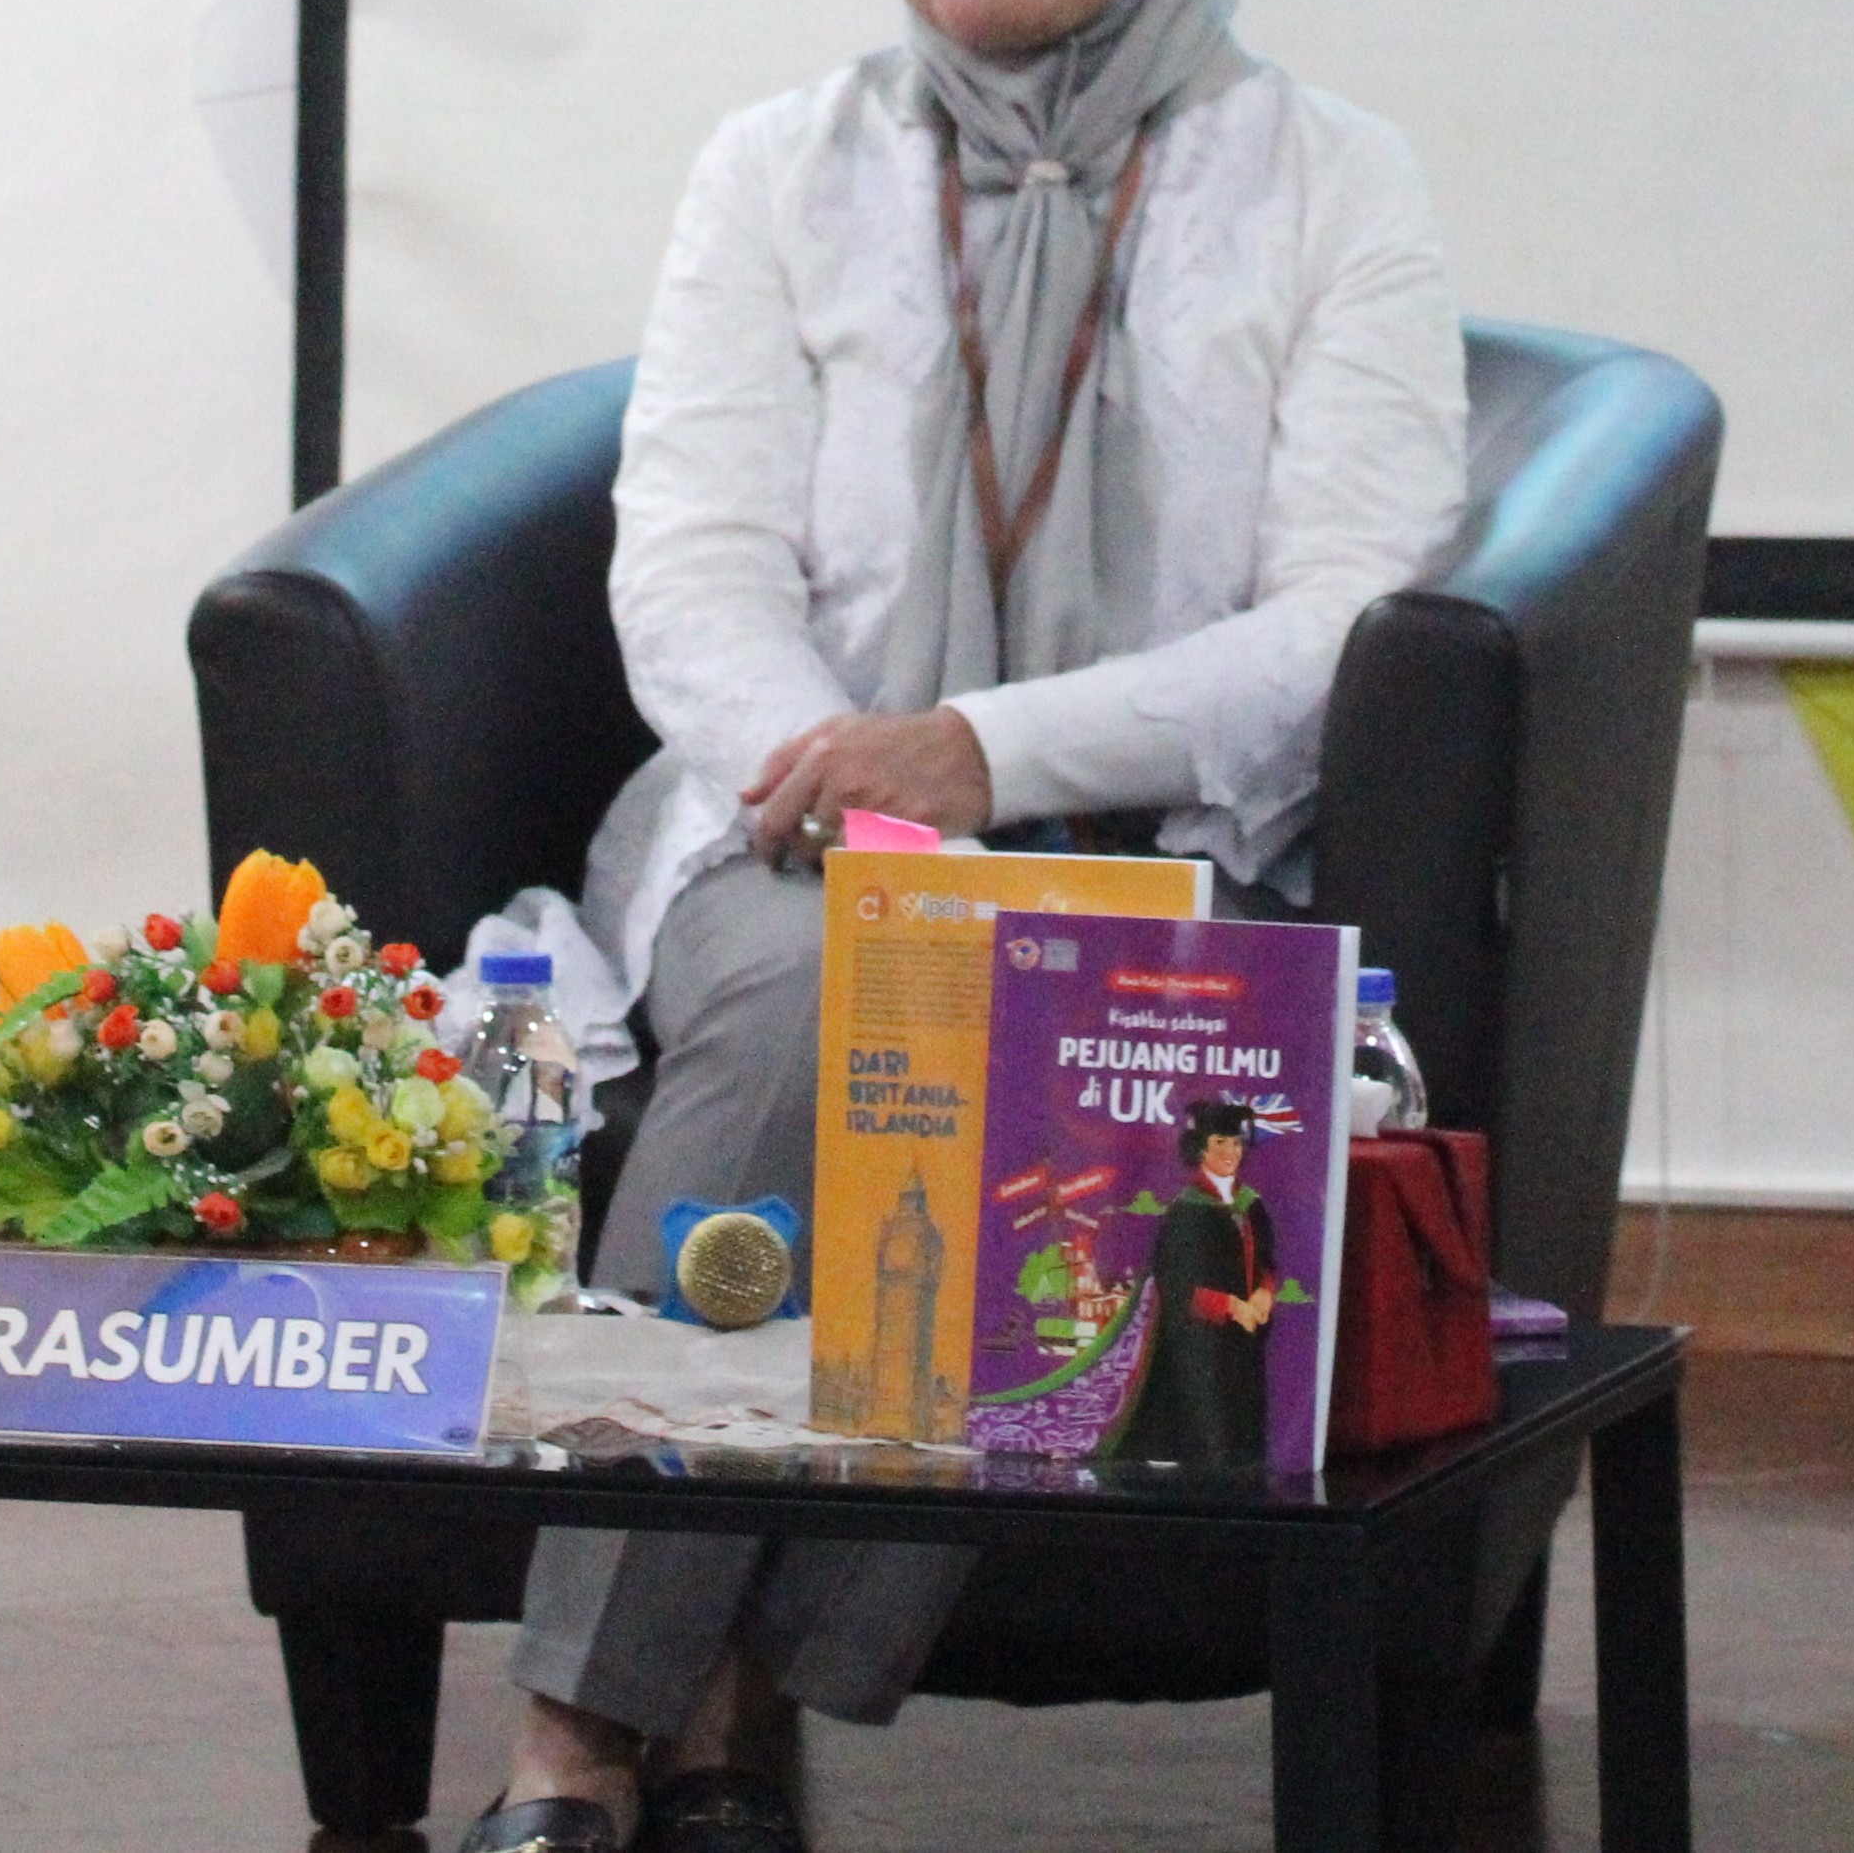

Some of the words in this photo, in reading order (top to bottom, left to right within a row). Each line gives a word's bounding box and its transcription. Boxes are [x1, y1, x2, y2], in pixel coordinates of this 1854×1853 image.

[849, 1048, 910, 1077] DARI
[1057, 1036, 1198, 1075] PEJUANG
[1205, 1045, 1282, 1080] ILMU
[1077, 1074, 1103, 1108] di
[1109, 1077, 1176, 1126] UK
[846, 1109, 958, 1138] IRLANDIA
